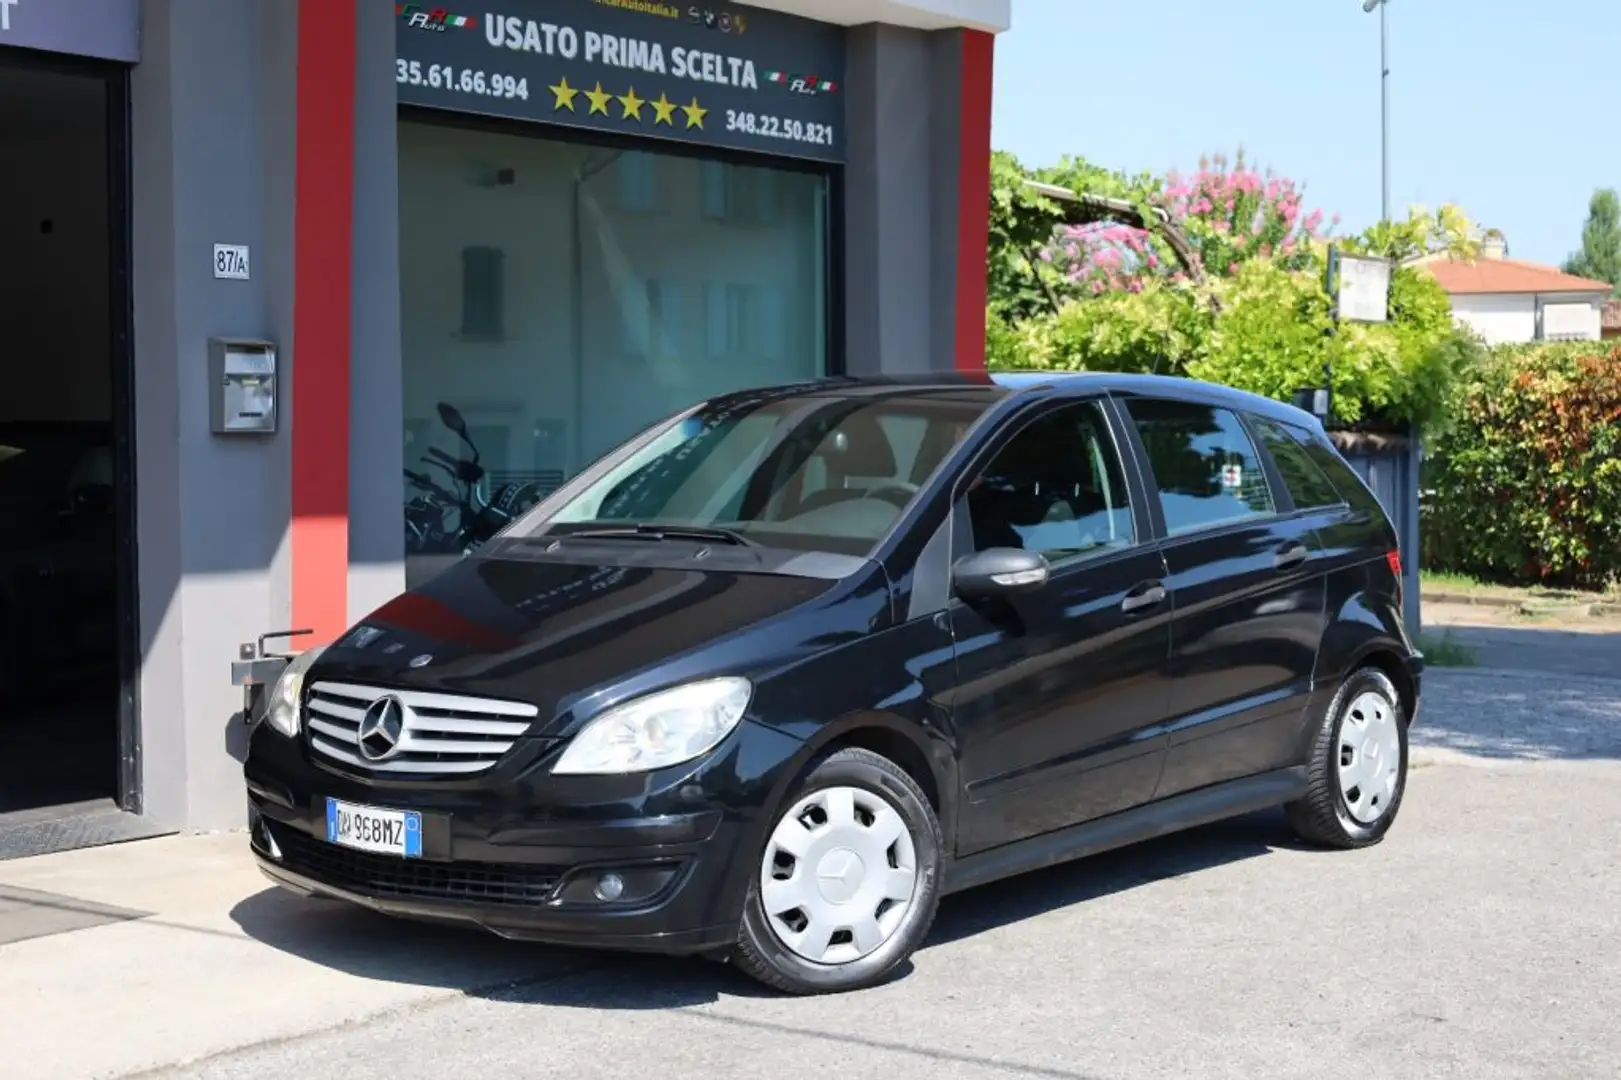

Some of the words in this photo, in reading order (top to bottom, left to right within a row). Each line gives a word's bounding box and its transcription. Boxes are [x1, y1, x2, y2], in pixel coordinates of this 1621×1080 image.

[485, 12, 578, 60] USATO
[584, 31, 667, 75] PRIMA
[671, 46, 759, 90] SCELTA
[396, 58, 529, 101] 35.61.66.994
[725, 109, 833, 146] 348.22.50.821
[216, 250, 246, 273] 87/A
[354, 813, 404, 847] 968MZ
